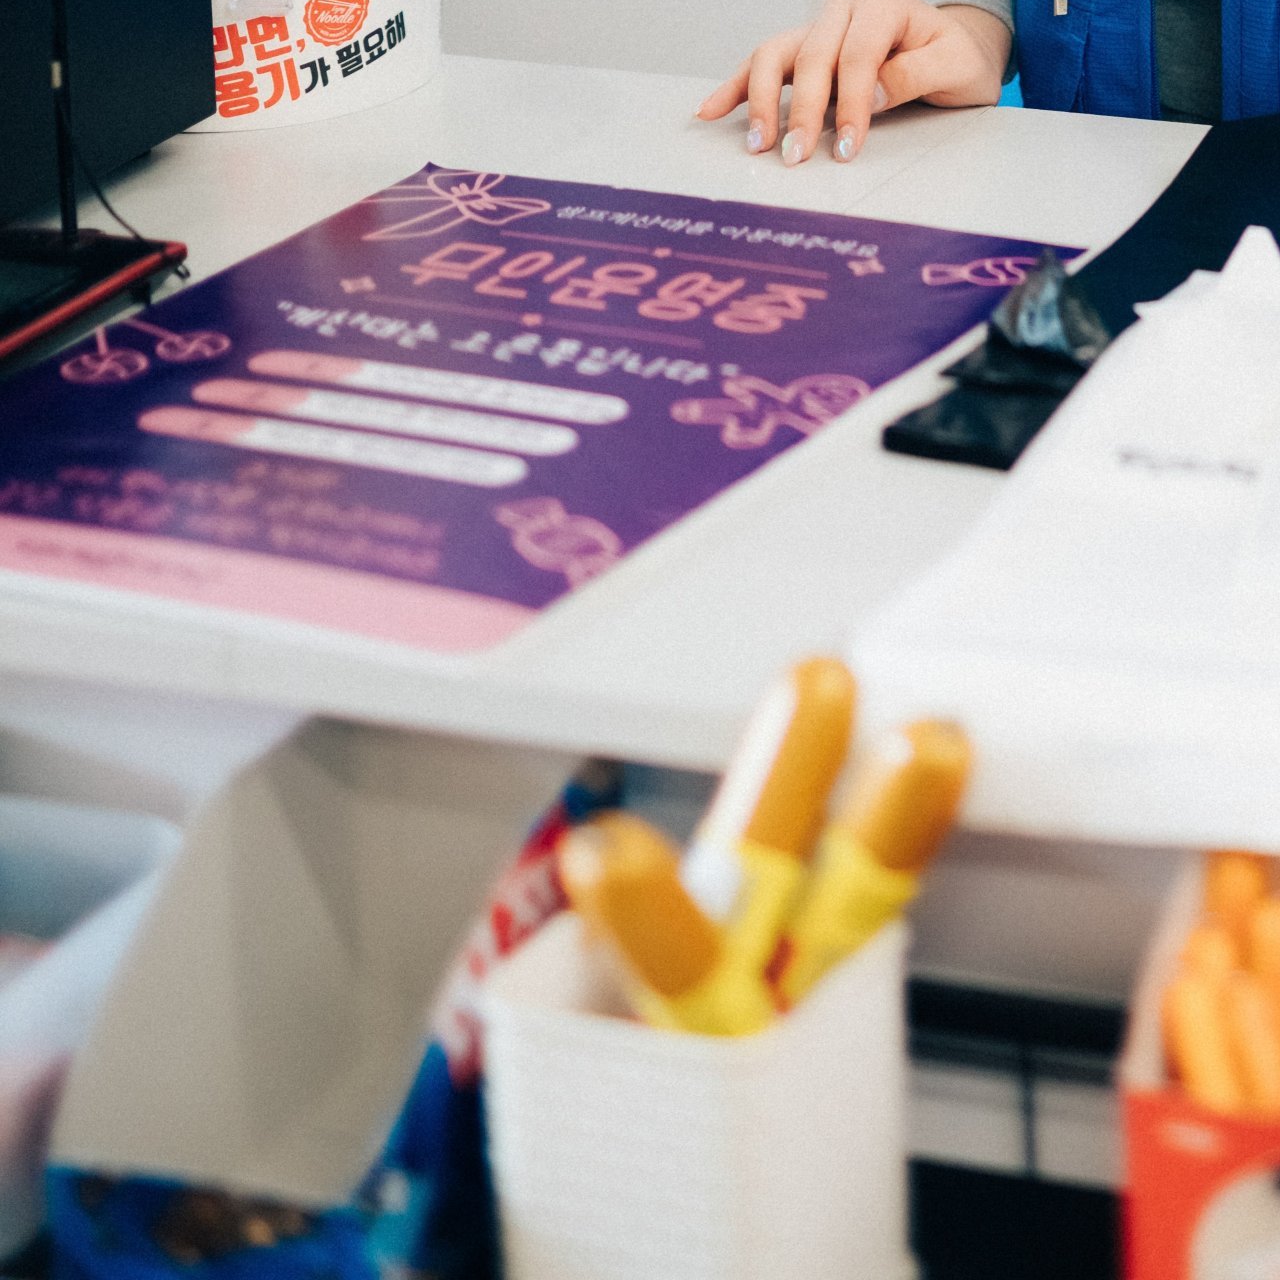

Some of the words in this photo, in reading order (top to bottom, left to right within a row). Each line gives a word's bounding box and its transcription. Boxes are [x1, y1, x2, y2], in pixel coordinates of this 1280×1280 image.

[315, 4, 357, 24] Noodle
[335, 10, 406, 78] 필요해
[400, 241, 829, 334] 무인운영중
